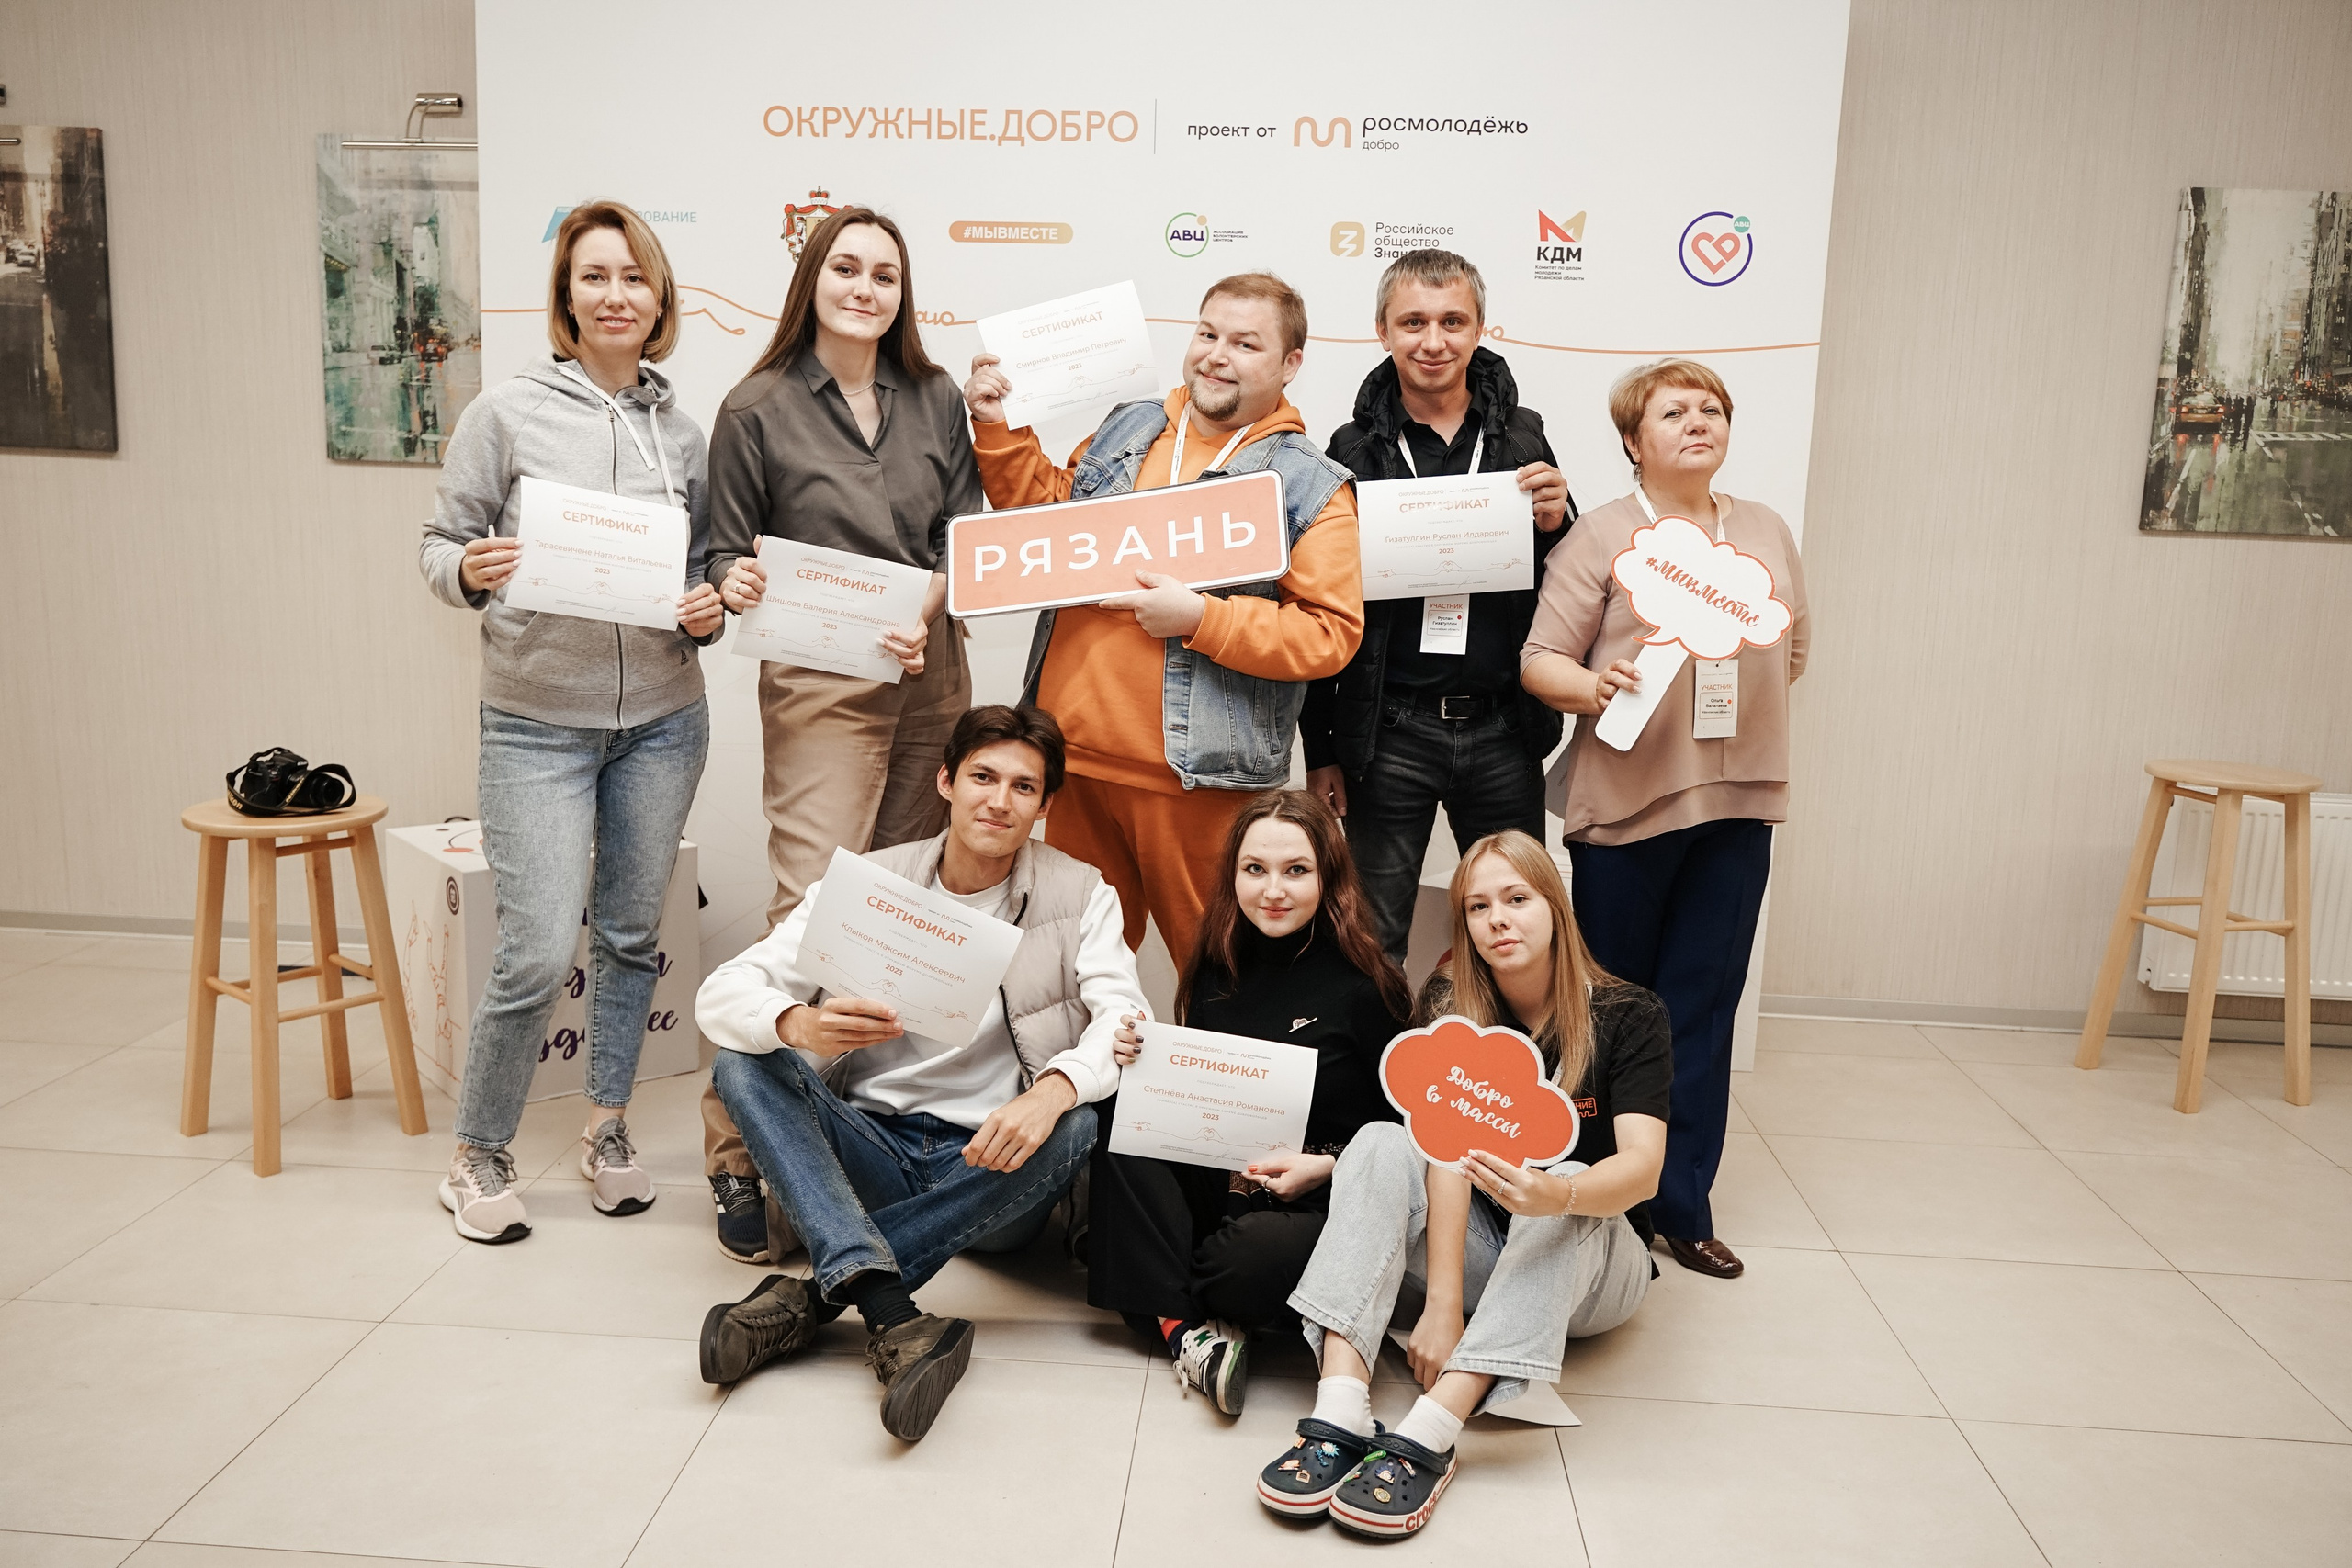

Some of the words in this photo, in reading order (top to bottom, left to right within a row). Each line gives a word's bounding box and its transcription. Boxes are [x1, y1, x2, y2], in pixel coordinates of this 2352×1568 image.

[763, 105, 1139, 147] ОКРУЖНЫЕ.ДОБРО
[1187, 123, 1250, 140] проект
[1256, 125, 1276, 138] от
[1363, 116, 1529, 138] росмолодёжь
[1362, 139, 1400, 152] добро
[963, 225, 1058, 241] #МЫВМЕСТЕ
[1170, 230, 1205, 241] АВЦ
[1375, 221, 1454, 235] Российское
[1374, 235, 1440, 248] общество
[1374, 247, 1408, 259] Знан
[1537, 246, 1582, 264] КДМ
[1022, 310, 1103, 339] СЕРТИФИКАТ
[1016, 356, 1051, 369] Смирнов
[1051, 346, 1091, 361] Владимир
[1091, 337, 1127, 351] Петрович
[1068, 363, 1082, 371] 2023
[562, 510, 649, 535] СЕРТИФИКАТ
[974, 512, 1257, 582] РЯЗАНЬ
[1385, 535, 1430, 544] Гизатуллин
[1433, 533, 1462, 541] Руслан
[594, 551, 626, 562] Наталья
[628, 555, 673, 570] Витальевна
[594, 567, 611, 575] 2023
[797, 569, 887, 595] СЕРТИФИКАТ
[765, 594, 801, 608] Шишова
[803, 602, 838, 615] Валерия
[840, 610, 900, 628] Александровна
[821, 622, 838, 630] 2023
[866, 896, 967, 947] СЕРТИФИКАТ
[841, 921, 874, 943] Клыков
[875, 939, 910, 961] Максим
[911, 956, 966, 984] Алексеевич
[885, 964, 904, 976] 2023
[1170, 1054, 1270, 1079] СЕРТИФИКАТ
[1446, 1066, 1514, 1109] Добро
[1187, 1092, 1234, 1107] Анастасия
[1236, 1100, 1285, 1116] Романовна
[1426, 1084, 1443, 1103] в
[1450, 1097, 1521, 1139] массы
[1202, 1112, 1219, 1121] 2023
